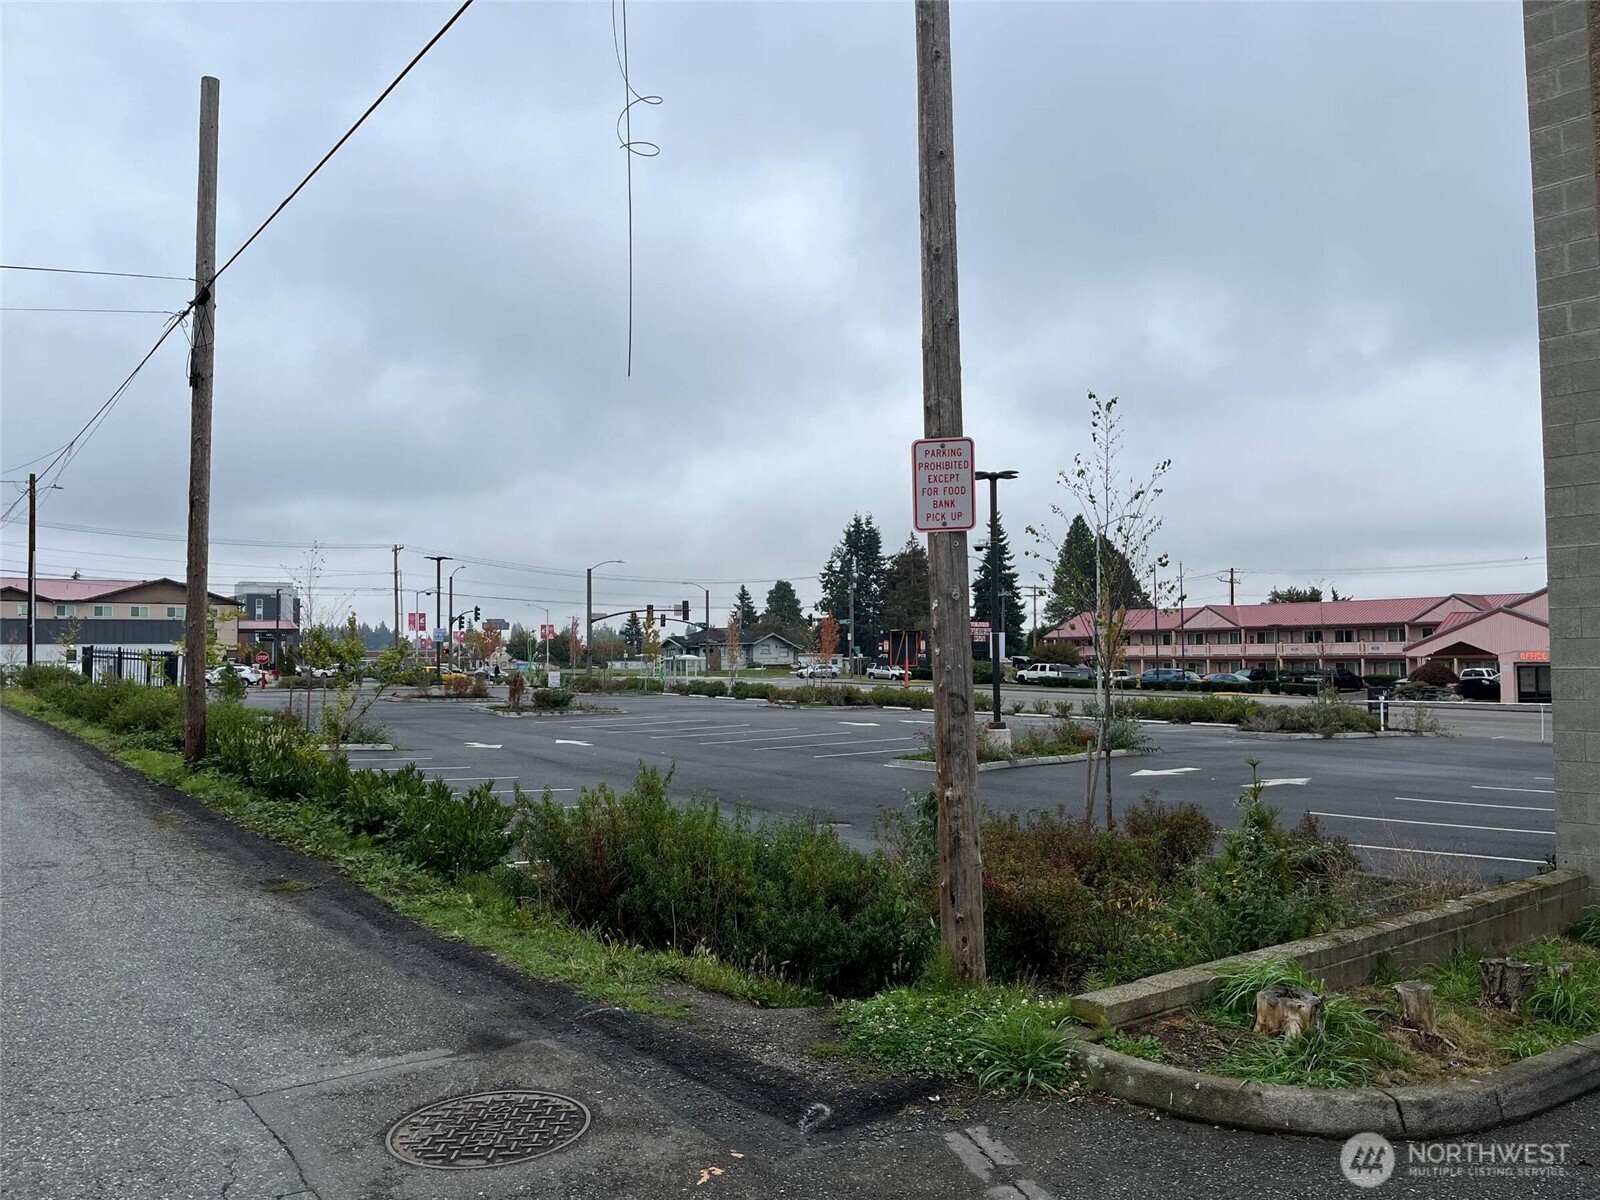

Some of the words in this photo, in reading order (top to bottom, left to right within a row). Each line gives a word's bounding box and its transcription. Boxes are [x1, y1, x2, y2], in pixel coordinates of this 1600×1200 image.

[925, 448, 962, 458] PARKING
[918, 460, 969, 471] PROHIBITED
[928, 473, 960, 483] EXCEPT
[921, 487, 939, 497] FOR
[943, 486, 966, 495] FOOD
[933, 499, 956, 509] BANK
[926, 512, 946, 522] PICK
[951, 511, 963, 521] UP
[1520, 652, 1547, 661] OFFICE
[464, 1106, 512, 1147] SEWER
